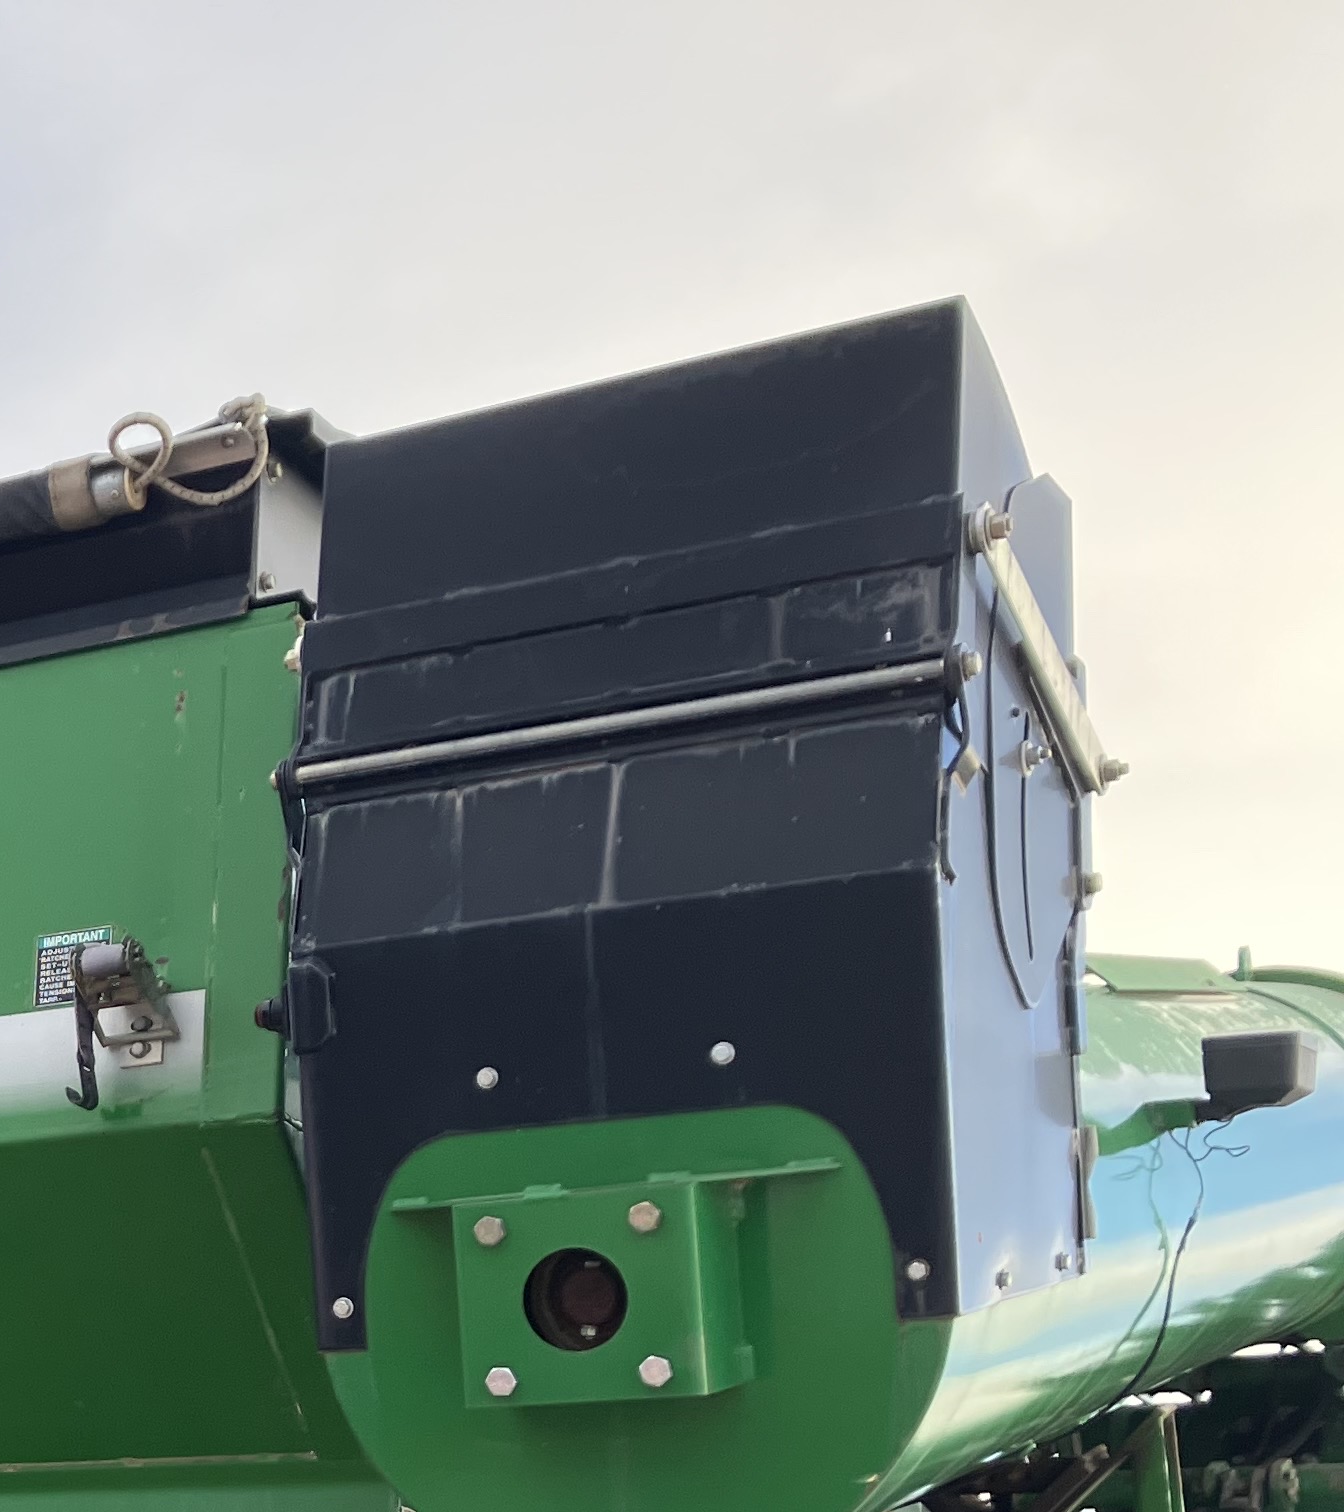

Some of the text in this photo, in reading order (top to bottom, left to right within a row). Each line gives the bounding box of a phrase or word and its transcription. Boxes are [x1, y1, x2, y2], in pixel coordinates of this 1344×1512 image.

[43, 929, 106, 948] IMPORTANT
[40, 961, 68, 970] SET-U
[40, 974, 73, 984] RATCHE
[38, 987, 75, 997] TENSION
